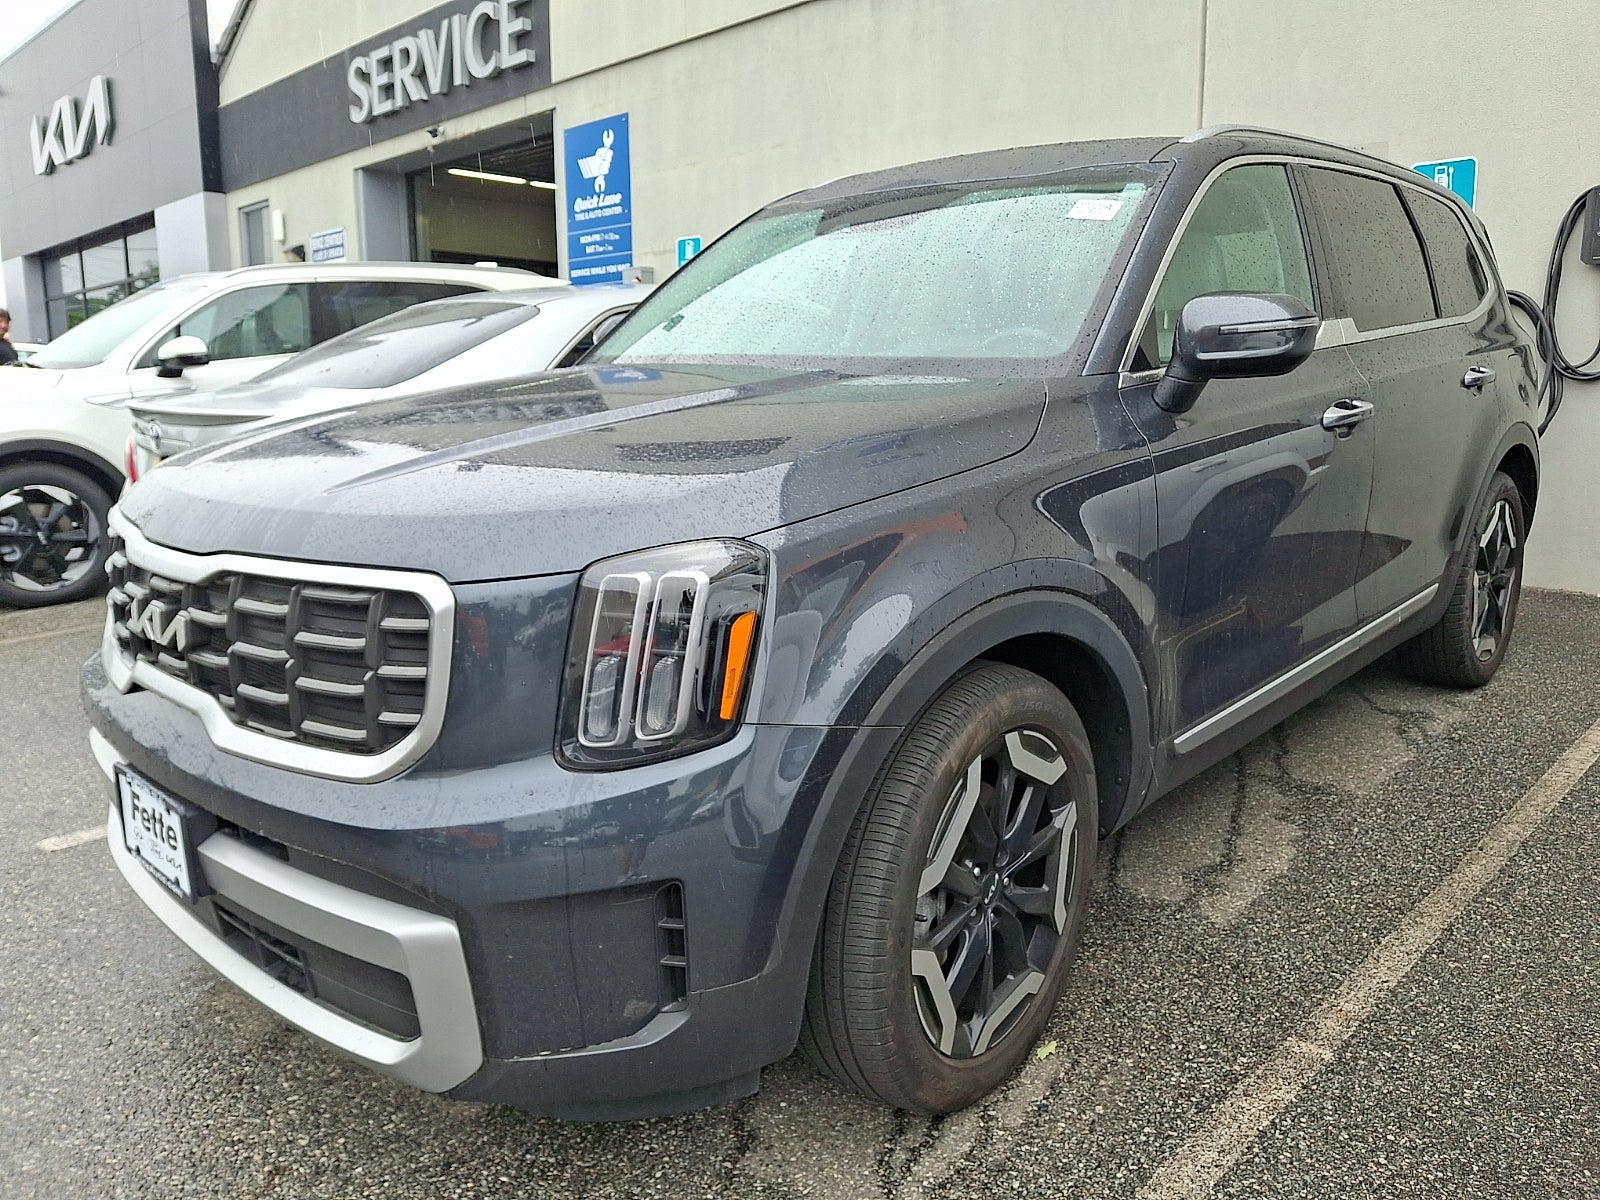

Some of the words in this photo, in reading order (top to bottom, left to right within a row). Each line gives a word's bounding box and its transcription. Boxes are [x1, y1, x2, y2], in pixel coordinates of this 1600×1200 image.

[348, 0, 535, 123] SERVICE
[30, 75, 110, 175] KIA
[574, 194, 598, 212] Quick
[599, 193, 622, 206] Lane
[131, 790, 178, 850] Fette
